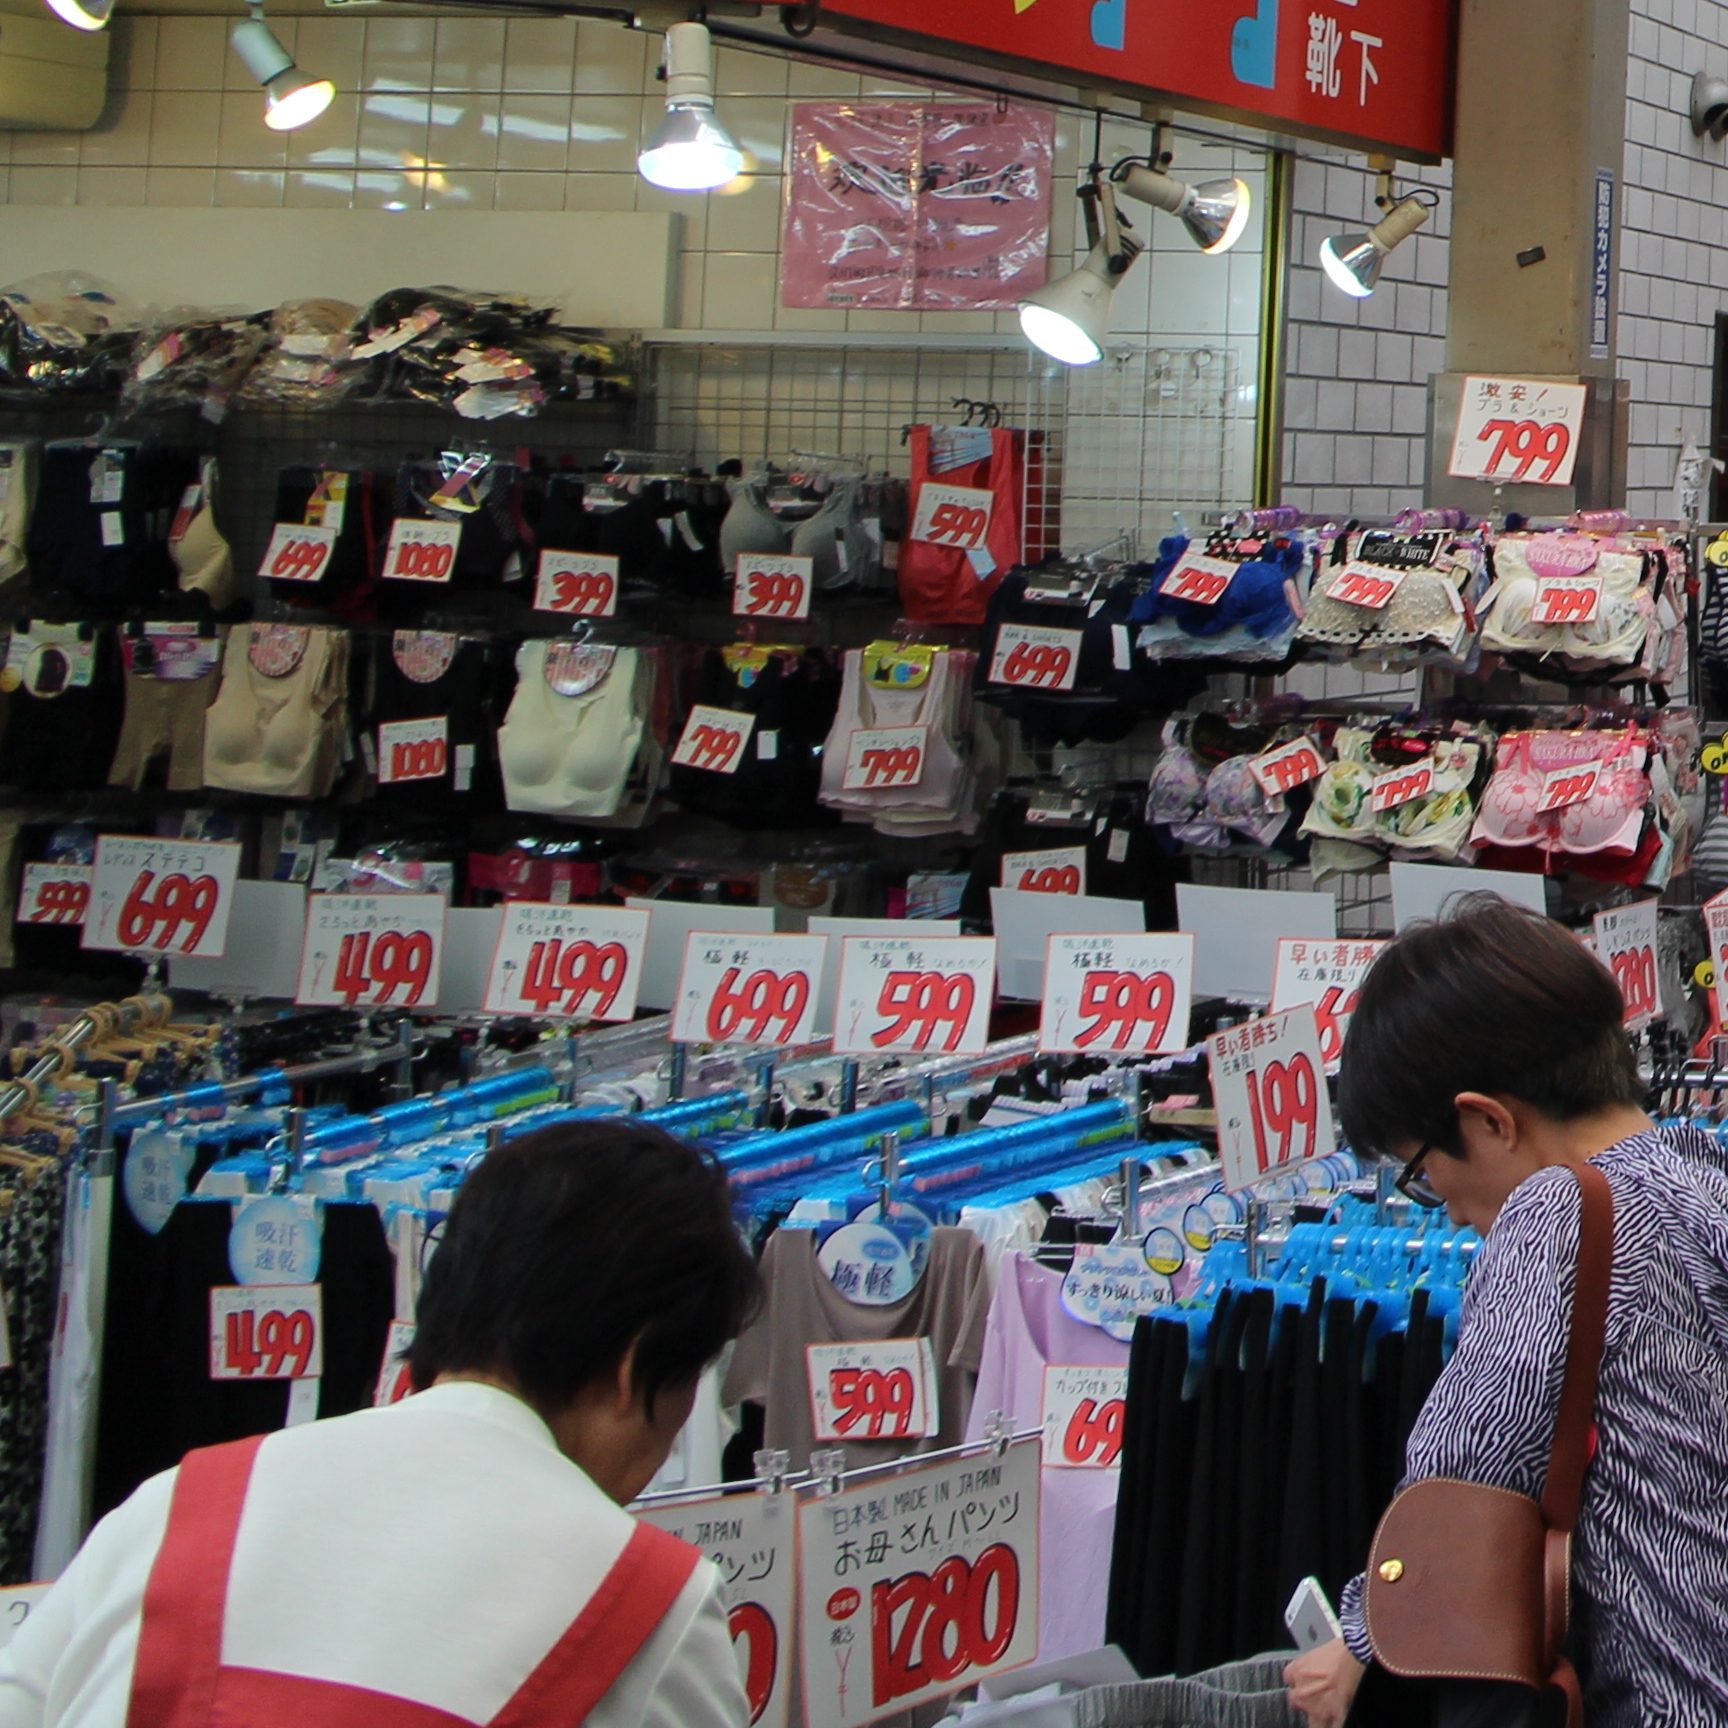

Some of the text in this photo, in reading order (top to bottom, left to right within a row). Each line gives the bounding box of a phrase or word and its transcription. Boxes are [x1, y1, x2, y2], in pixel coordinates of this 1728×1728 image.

[1303, 12, 1384, 107] 靴下
[1477, 418, 1570, 481] 799
[926, 502, 987, 546] 599
[271, 540, 328, 580] 699
[394, 541, 453, 578] 1080
[1399, 548, 1430, 562] WHITE
[549, 571, 614, 615] 399
[745, 571, 804, 616] 399
[1170, 564, 1230, 604] 799
[1335, 572, 1396, 609] 799
[1541, 587, 1597, 622] 799
[1002, 641, 1071, 687] 699
[391, 737, 446, 782] 1080
[689, 725, 741, 769] 799
[860, 746, 920, 786] 799
[1262, 748, 1319, 794] 799
[1377, 768, 1433, 810] 799
[1545, 770, 1599, 812] 799
[140, 850, 207, 873] ステテコ
[31, 880, 91, 924] 599
[117, 869, 219, 955] 699
[332, 929, 433, 1005] 499
[519, 938, 627, 1018] 499
[705, 967, 810, 1045] 699
[870, 970, 975, 1052] 599
[1072, 970, 1175, 1050] 599
[1246, 1051, 1318, 1175] 199
[253, 1220, 300, 1246] 吸汗
[253, 1247, 298, 1274] 速乾
[832, 1258, 892, 1299] 極軽
[225, 1309, 314, 1377] 499
[829, 1367, 914, 1436] 599
[833, 1468, 1002, 1535] 日本製 MADE IN JAPAN
[694, 1518, 744, 1545] JAPAN
[872, 1541, 1021, 1708] 1280
